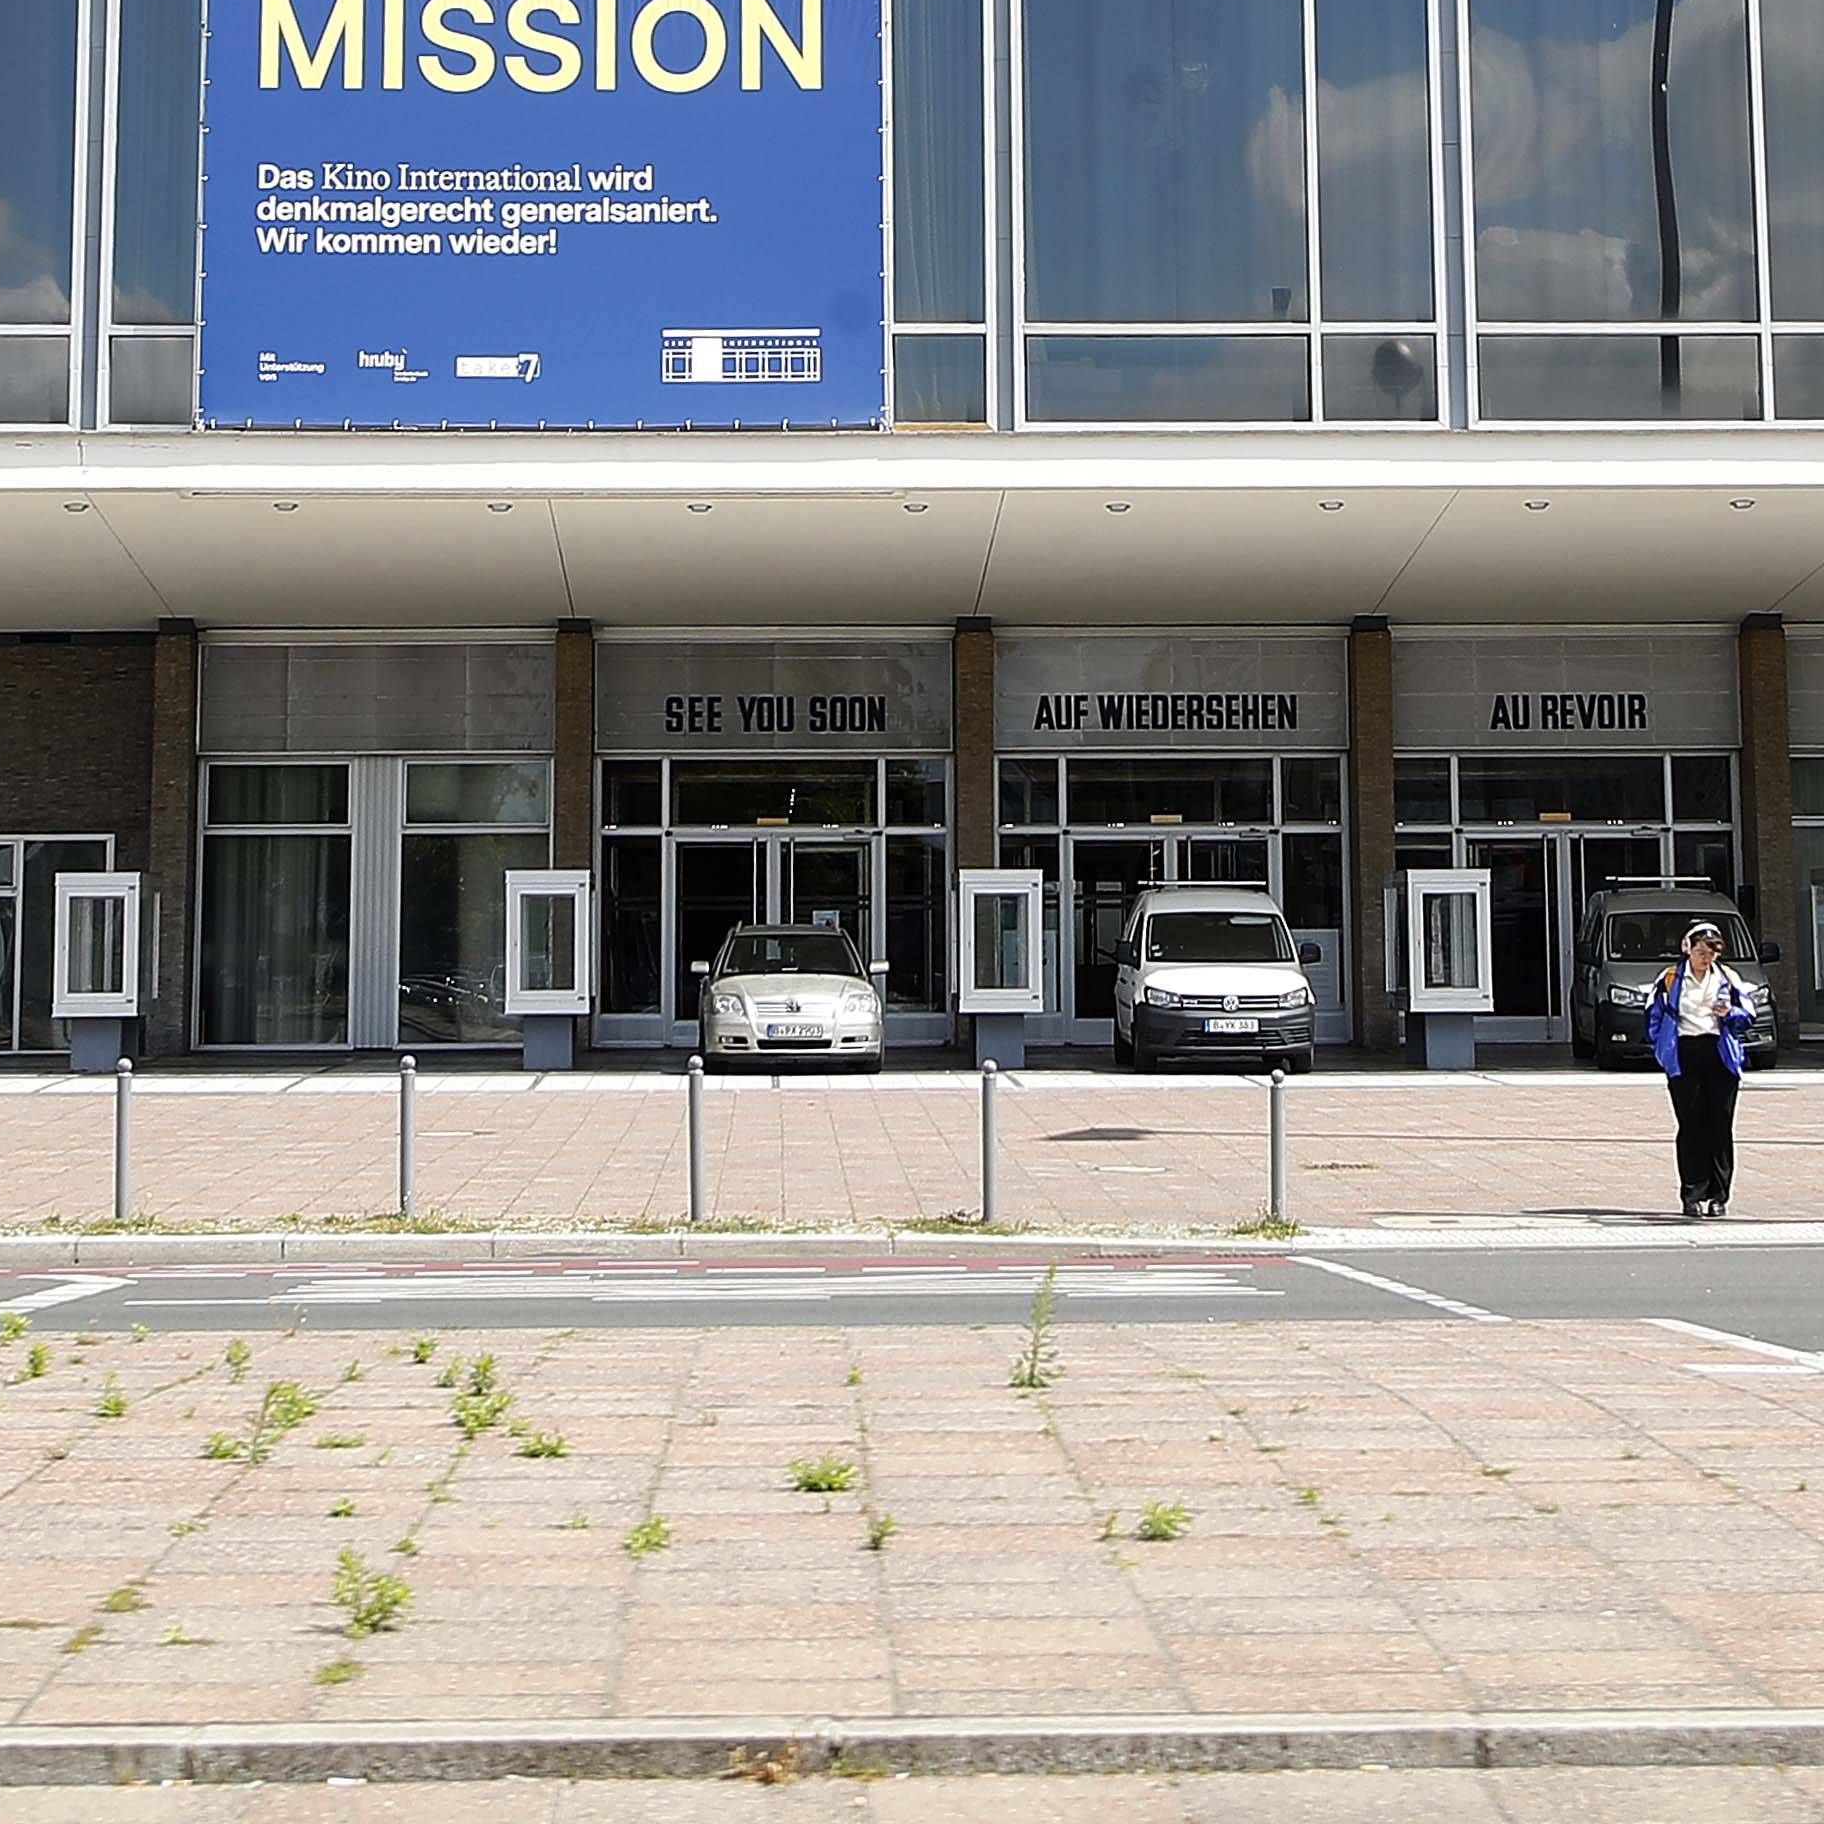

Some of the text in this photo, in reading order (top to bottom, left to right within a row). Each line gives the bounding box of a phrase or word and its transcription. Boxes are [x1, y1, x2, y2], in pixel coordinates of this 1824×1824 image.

[258, 163, 653, 193] Das Kino International wird
[256, 195, 718, 225] denkmalgerecht generalsaniert.
[256, 225, 558, 255] Wir kommen wieder!
[665, 695, 887, 733] SEE YOU SOON
[1033, 693, 1298, 731] AUF WIEDERSEHEN
[1489, 693, 1648, 731] AU REVOIR
